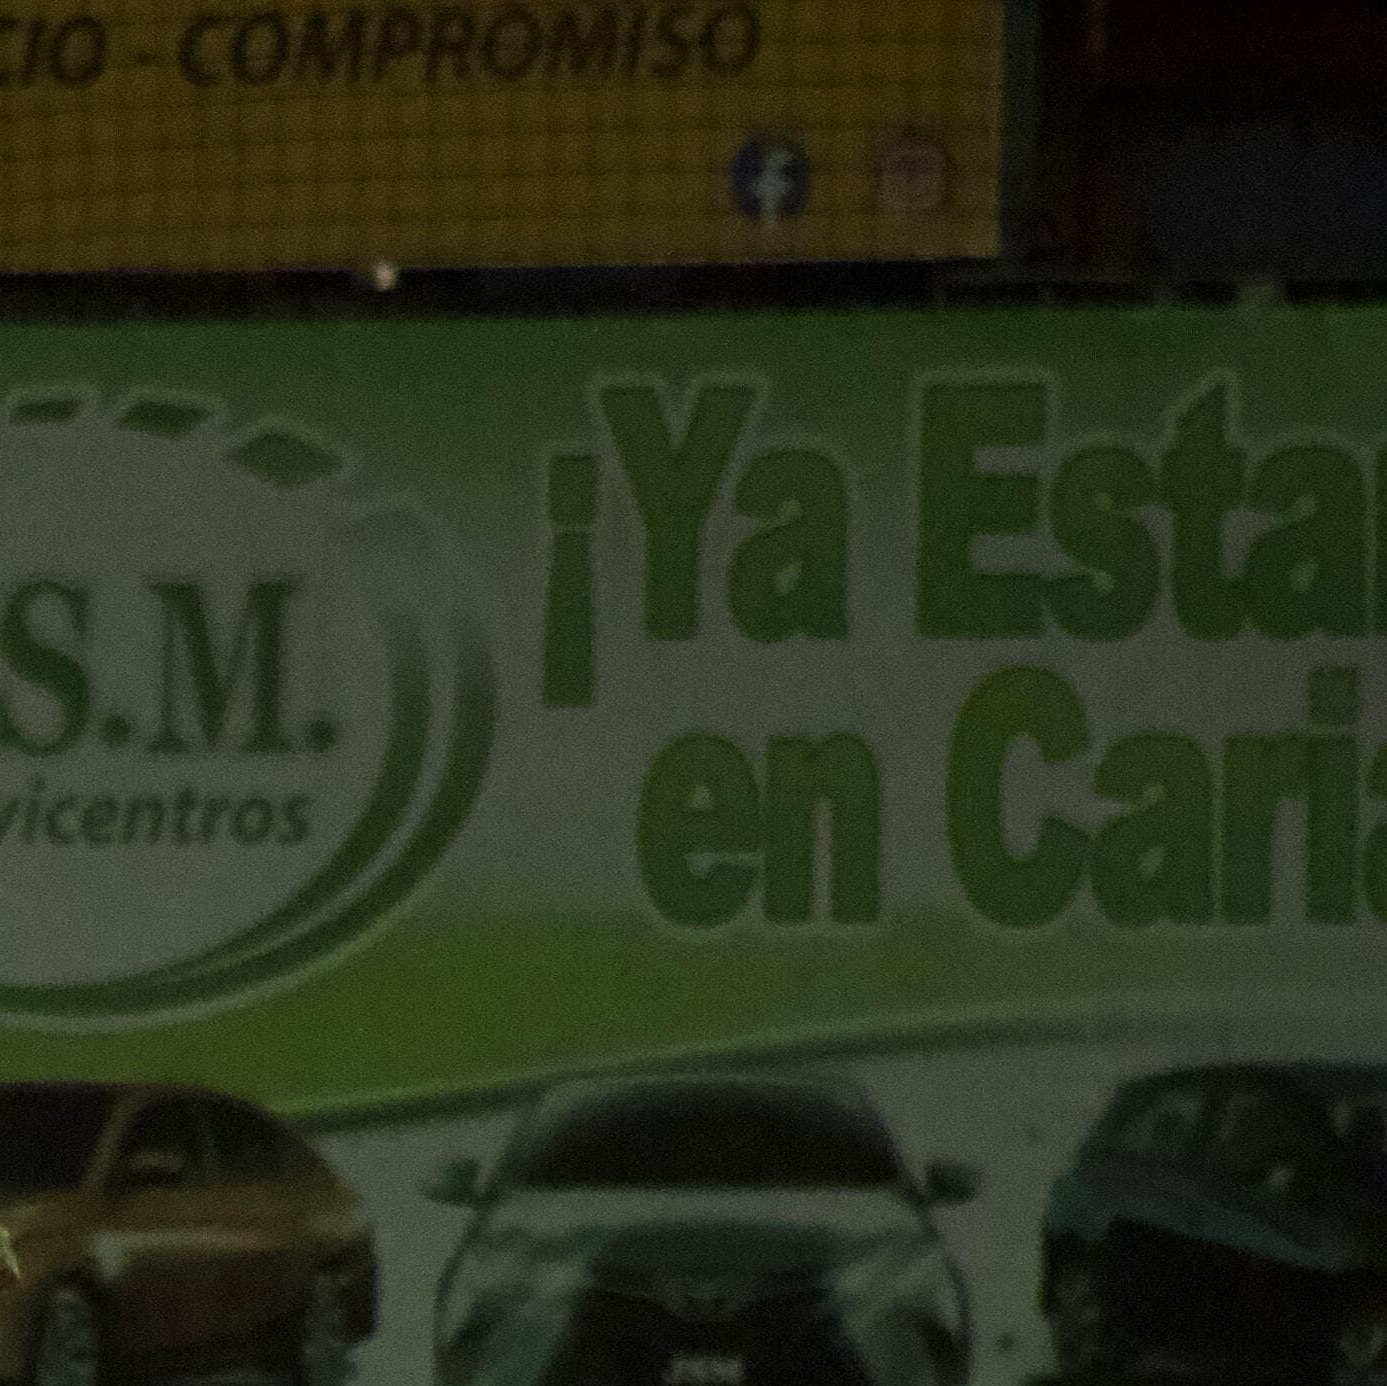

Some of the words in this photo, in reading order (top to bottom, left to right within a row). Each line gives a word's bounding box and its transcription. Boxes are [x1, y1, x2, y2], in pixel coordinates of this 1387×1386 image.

[178, 4, 763, 90] COMPROMISO
[915, 380, 1387, 642] Esta
[637, 731, 881, 927] en
[947, 664, 1387, 929] Cari
